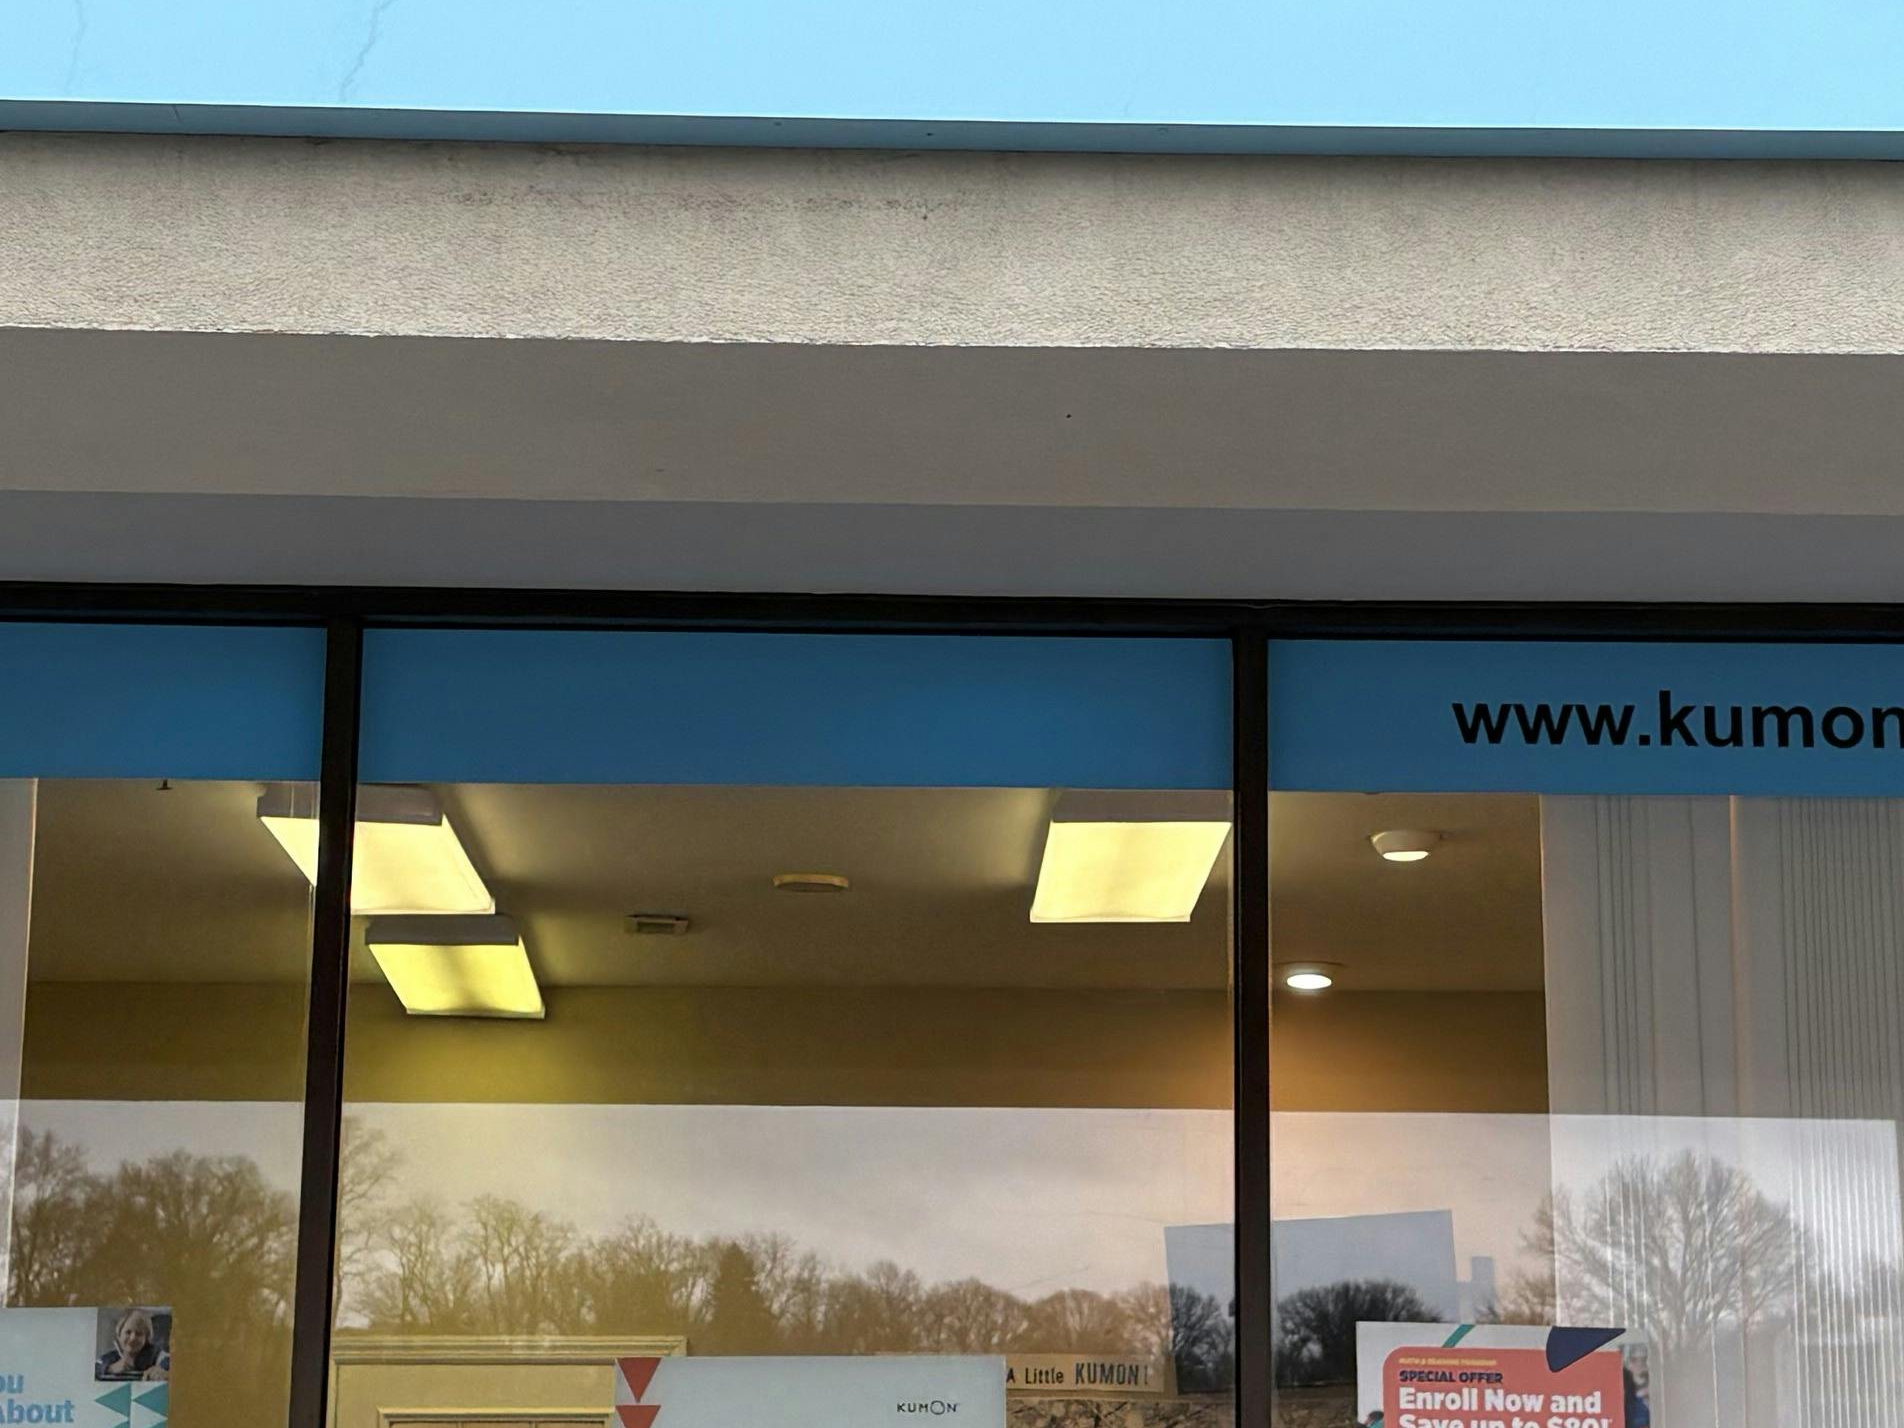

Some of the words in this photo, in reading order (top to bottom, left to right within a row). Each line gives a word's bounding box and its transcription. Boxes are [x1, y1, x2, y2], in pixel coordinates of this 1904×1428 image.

[1025, 1367, 1064, 1384] Little
[1399, 1370, 1456, 1383] SPECIAL
[1458, 1372, 1503, 1384] OFFER
[1399, 1387, 1478, 1411] Enroll
[1484, 1389, 1544, 1413] Now
[1550, 1391, 1601, 1414] and
